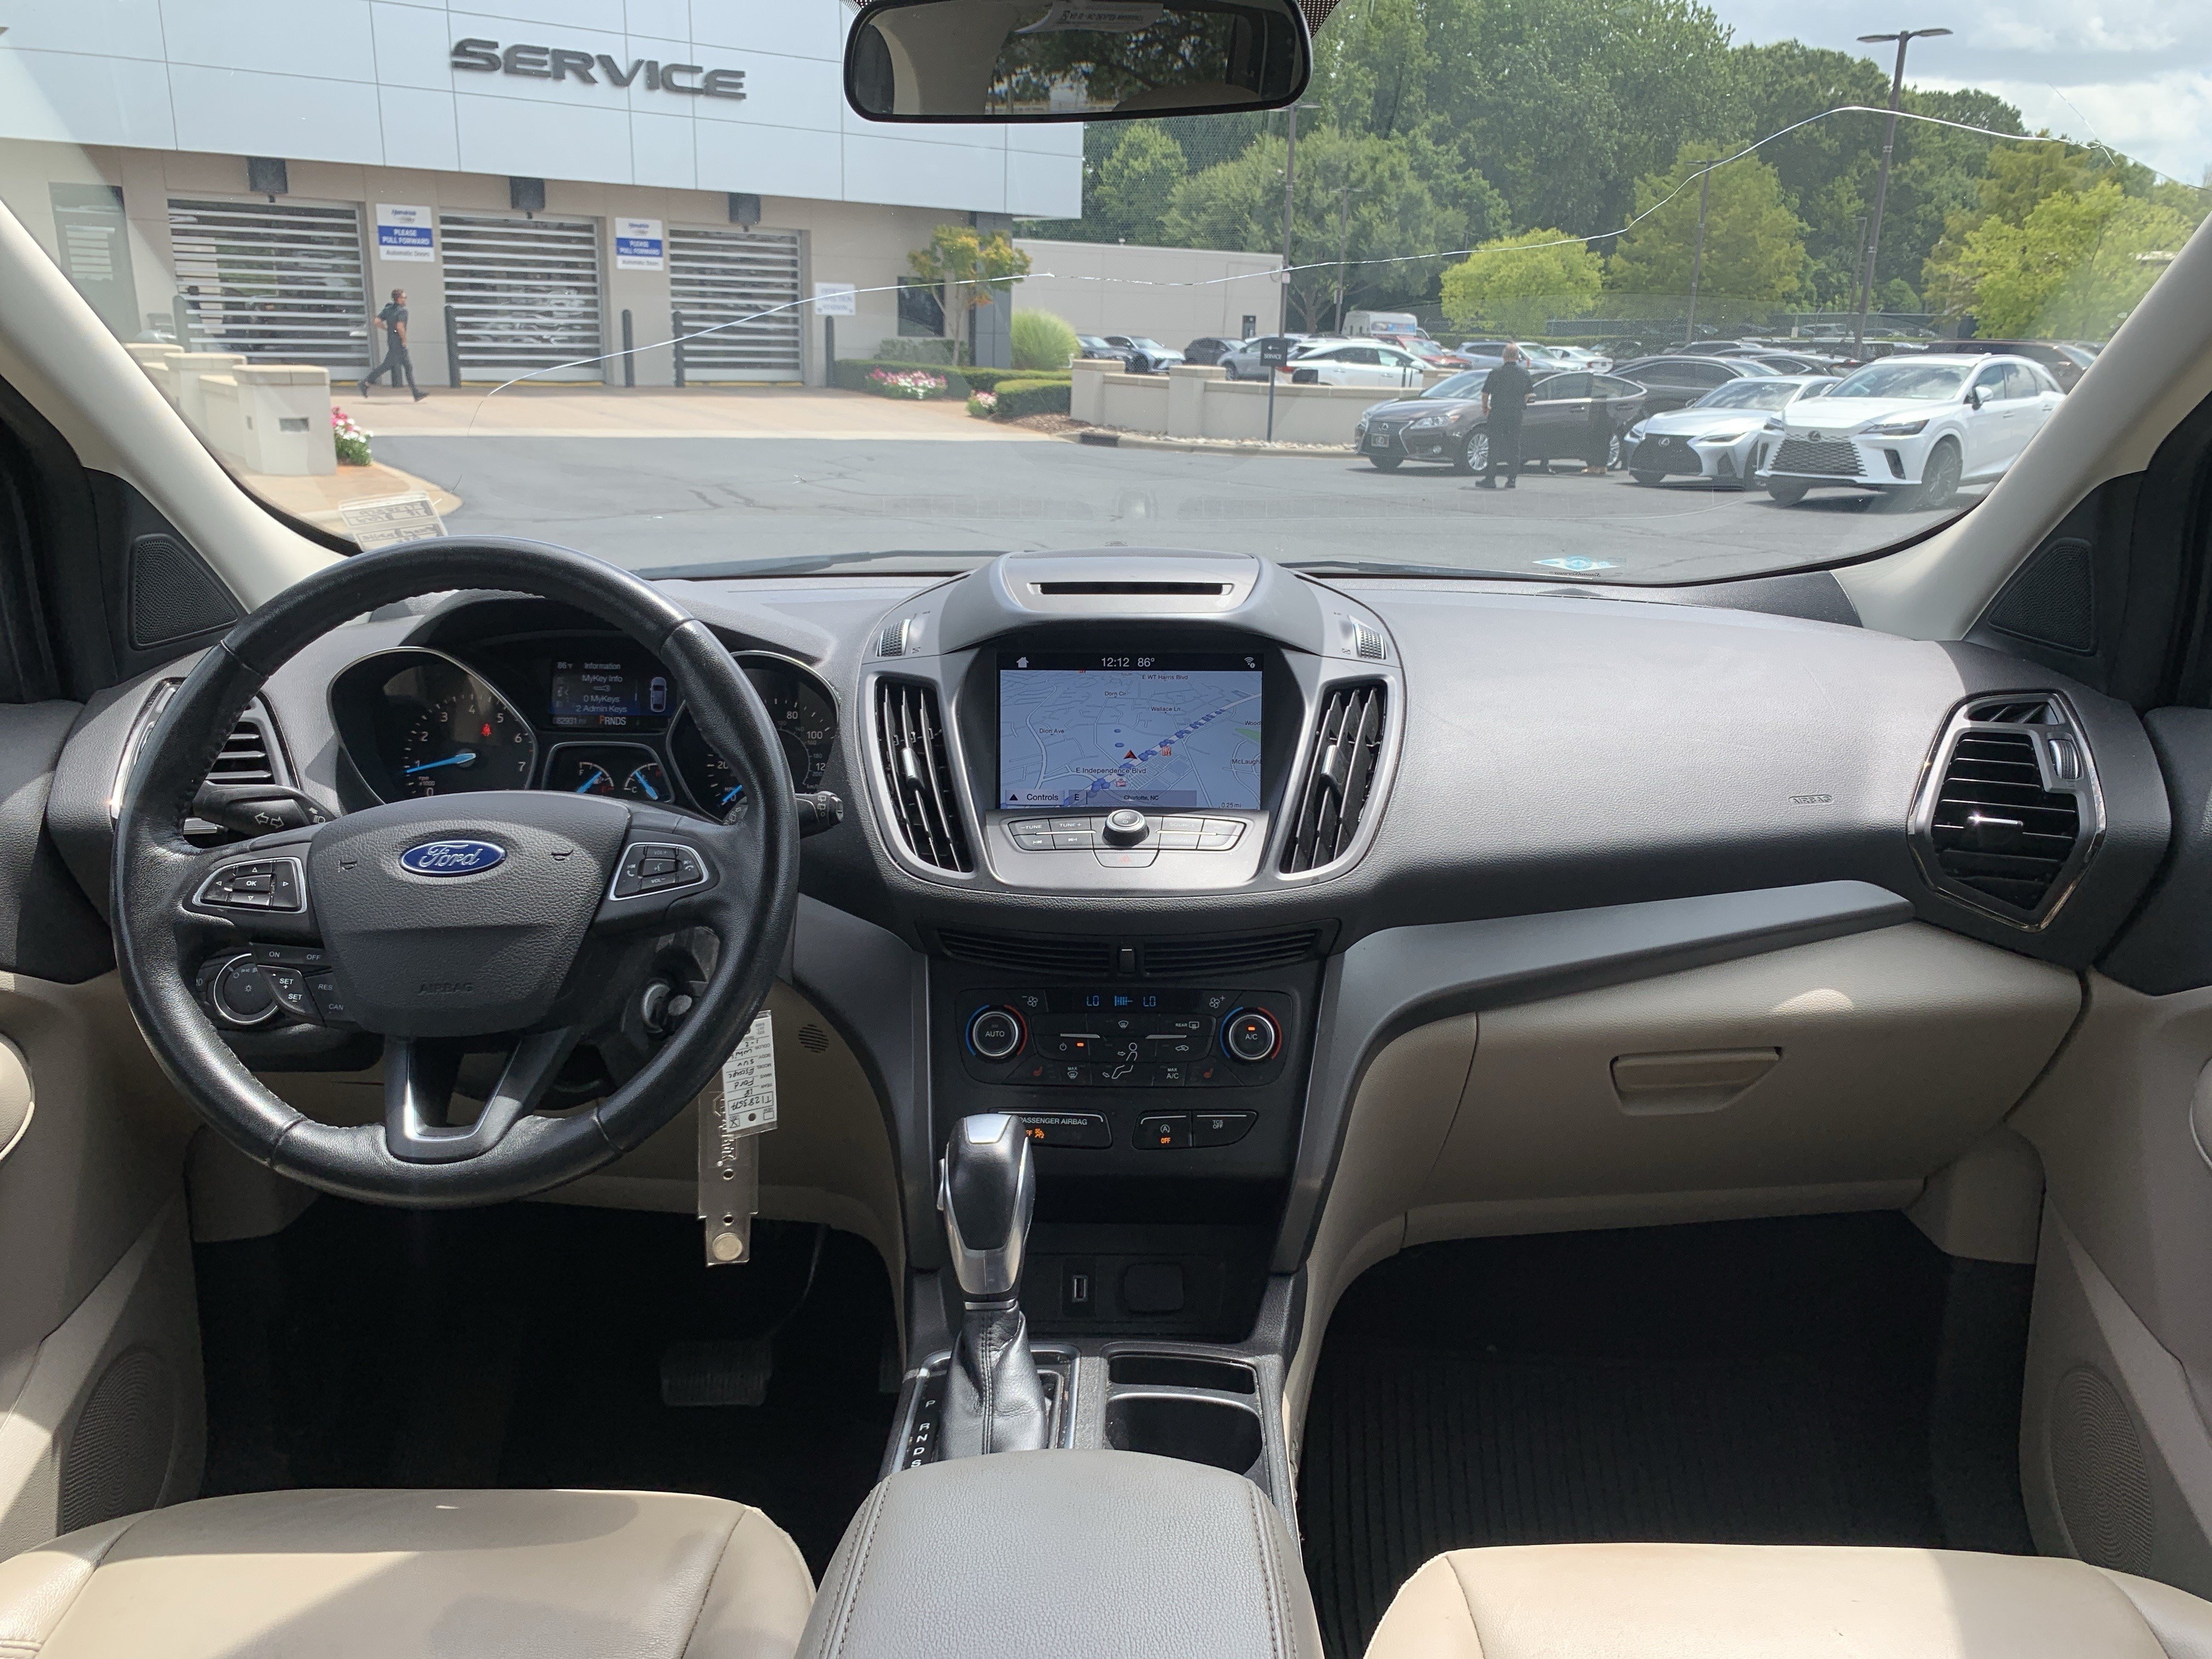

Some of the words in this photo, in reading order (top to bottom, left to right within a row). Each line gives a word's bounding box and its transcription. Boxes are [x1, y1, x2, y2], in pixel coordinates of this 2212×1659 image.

[451, 37, 747, 100] SERVICE
[398, 237, 430, 245] FORWARD
[1101, 657, 1130, 667] 12:12
[1137, 657, 1155, 667] 86°
[583, 675, 607, 684] MyKey
[591, 695, 620, 703] MyKeys
[469, 704, 476, 714] 4
[609, 705, 627, 714] Keys
[441, 712, 448, 722] 3
[496, 713, 504, 723] 5
[600, 715, 627, 725] PRNDS
[786, 710, 798, 720] 80
[421, 731, 428, 741] 2
[515, 733, 522, 743] 6
[806, 730, 823, 740] 100
[518, 761, 526, 771] 7
[816, 763, 826, 771] 12
[426, 787, 434, 796] 0
[1026, 793, 1059, 802] Controls
[1792, 796, 1831, 804] AIRBAG
[419, 844, 483, 868] Ford
[418, 981, 474, 995] AIRBAG
[734, 1077, 754, 1090] Ford
[926, 1400, 935, 1408] P
[919, 1423, 930, 1432] R
[916, 1434, 928, 1443] N
[913, 1447, 925, 1457] D
[911, 1459, 922, 1468] S
